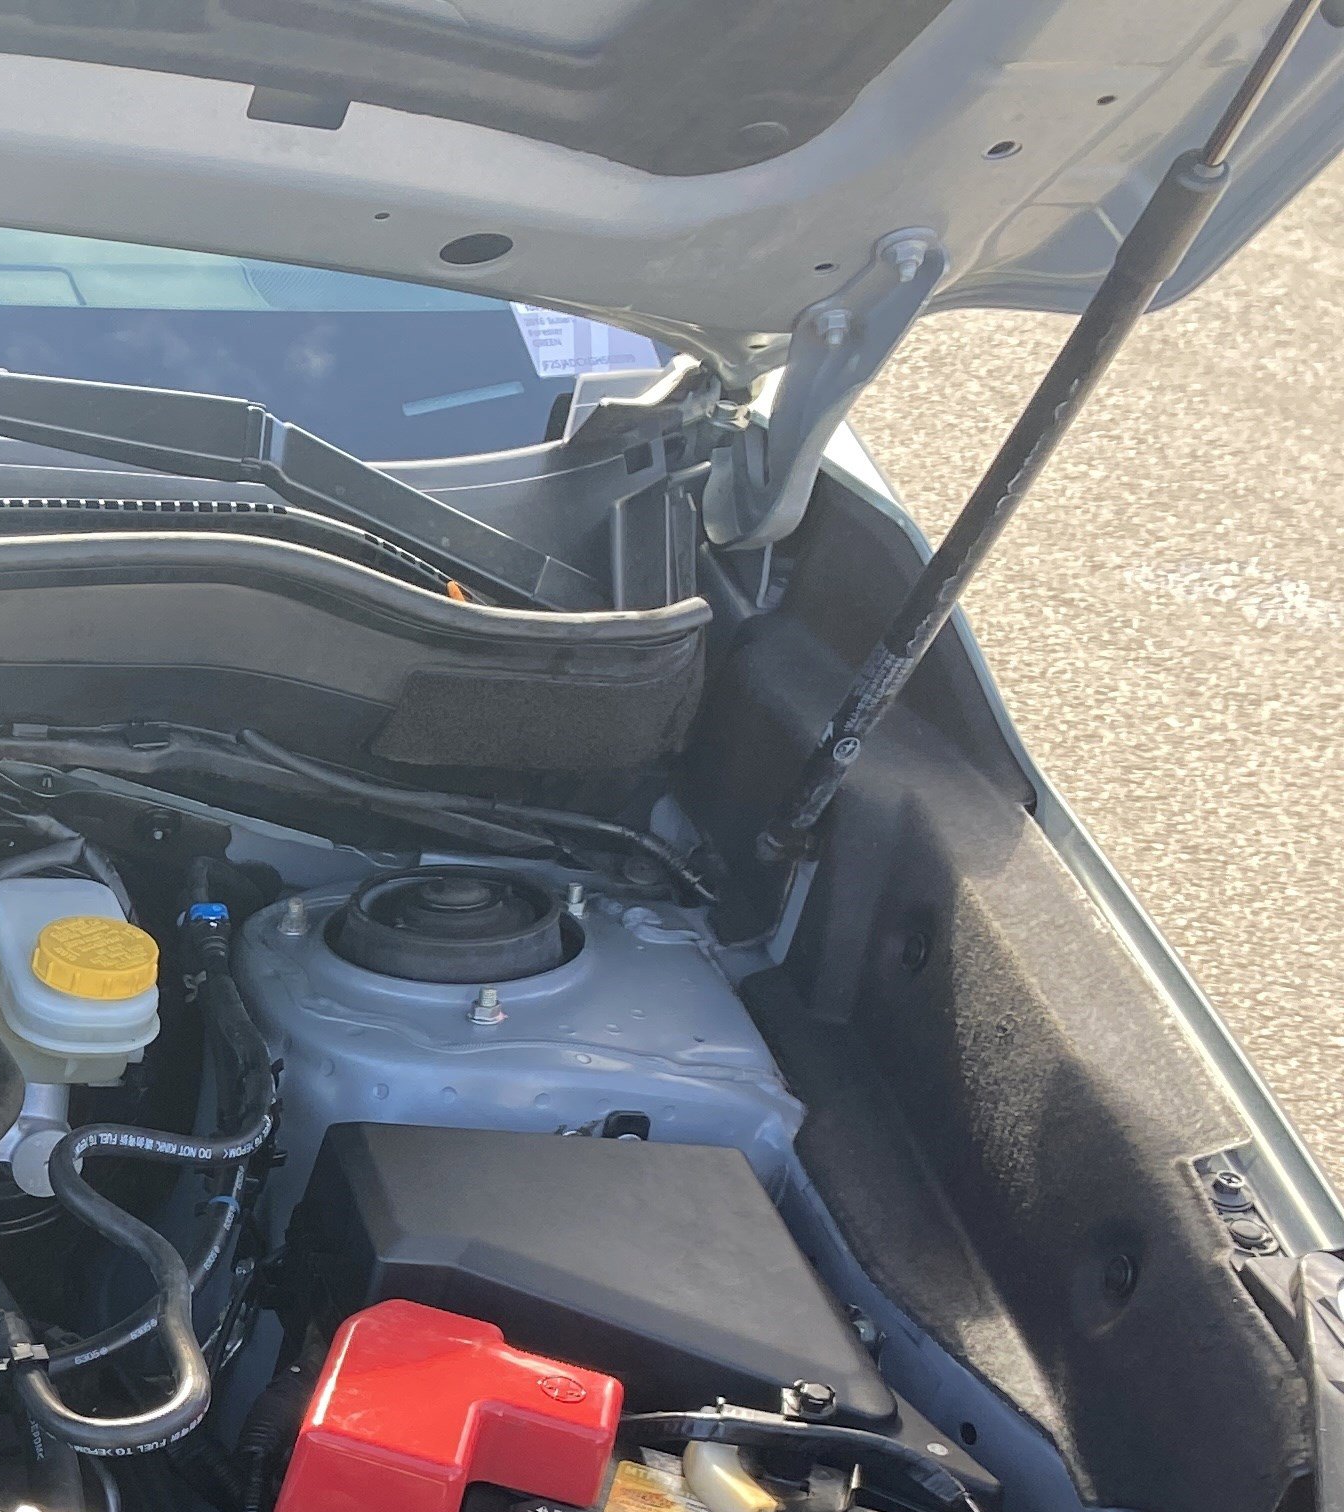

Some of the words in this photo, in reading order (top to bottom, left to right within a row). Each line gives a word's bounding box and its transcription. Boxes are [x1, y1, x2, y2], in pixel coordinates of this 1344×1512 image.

[98, 1132, 118, 1145] FUEL
[178, 1145, 197, 1158] NOT
[198, 1147, 212, 1160] DO
[137, 1438, 168, 1453] FUEL
[115, 1448, 134, 1457] TO
